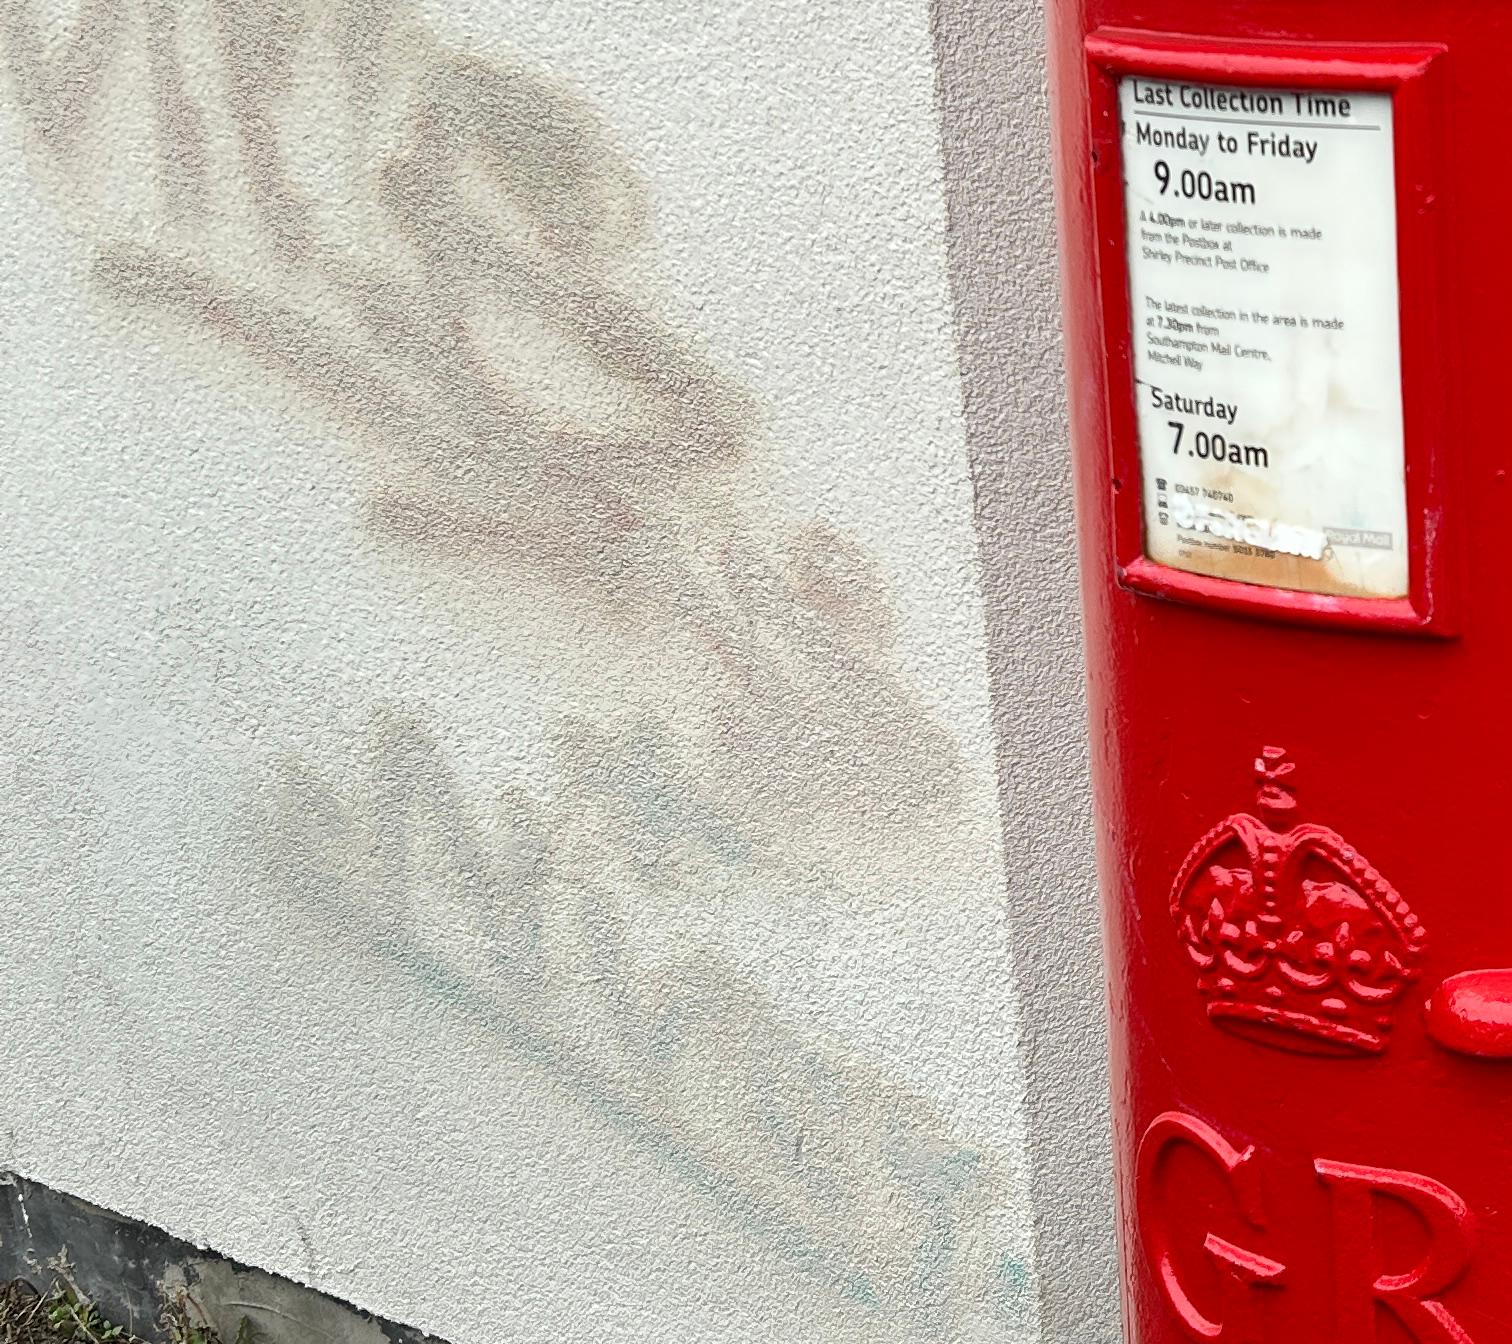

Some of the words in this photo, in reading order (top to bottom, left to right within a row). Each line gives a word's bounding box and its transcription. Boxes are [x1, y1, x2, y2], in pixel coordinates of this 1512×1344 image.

[1133, 80, 1174, 106] Last
[1180, 86, 1283, 115] Collection
[1292, 92, 1351, 117] Time
[1136, 122, 1210, 156] Monday
[1218, 131, 1238, 154] to
[1248, 132, 1318, 163] Friday
[1154, 160, 1256, 204] 9.00am
[1141, 228, 1162, 243] from
[1165, 231, 1179, 245] the
[1182, 233, 1219, 250] Postbox
[1223, 240, 1232, 251] at
[1188, 217, 1198, 229] or
[1201, 217, 1222, 232] later
[1226, 221, 1275, 238] collection
[1278, 226, 1287, 238] is
[1290, 226, 1323, 240] made
[1142, 246, 1172, 264] Shirley
[1175, 250, 1212, 267] Precinct
[1216, 256, 1237, 270] Post
[1240, 258, 1270, 273] Office
[1146, 296, 1161, 311] The
[1165, 301, 1188, 315] latest
[1192, 305, 1235, 320] collection
[1239, 311, 1249, 322] in
[1252, 311, 1269, 324] the
[1273, 317, 1296, 327] area
[1300, 317, 1308, 328] is
[1312, 318, 1344, 330] made
[1147, 317, 1155, 327] at
[1196, 322, 1219, 336] from
[1147, 331, 1208, 353] Southampton
[1211, 342, 1231, 356] Mail
[1185, 357, 1203, 372] Way
[1151, 387, 1238, 425] Saturday
[1167, 420, 1269, 468] 7.00am
[1363, 532, 1391, 547] Mail
